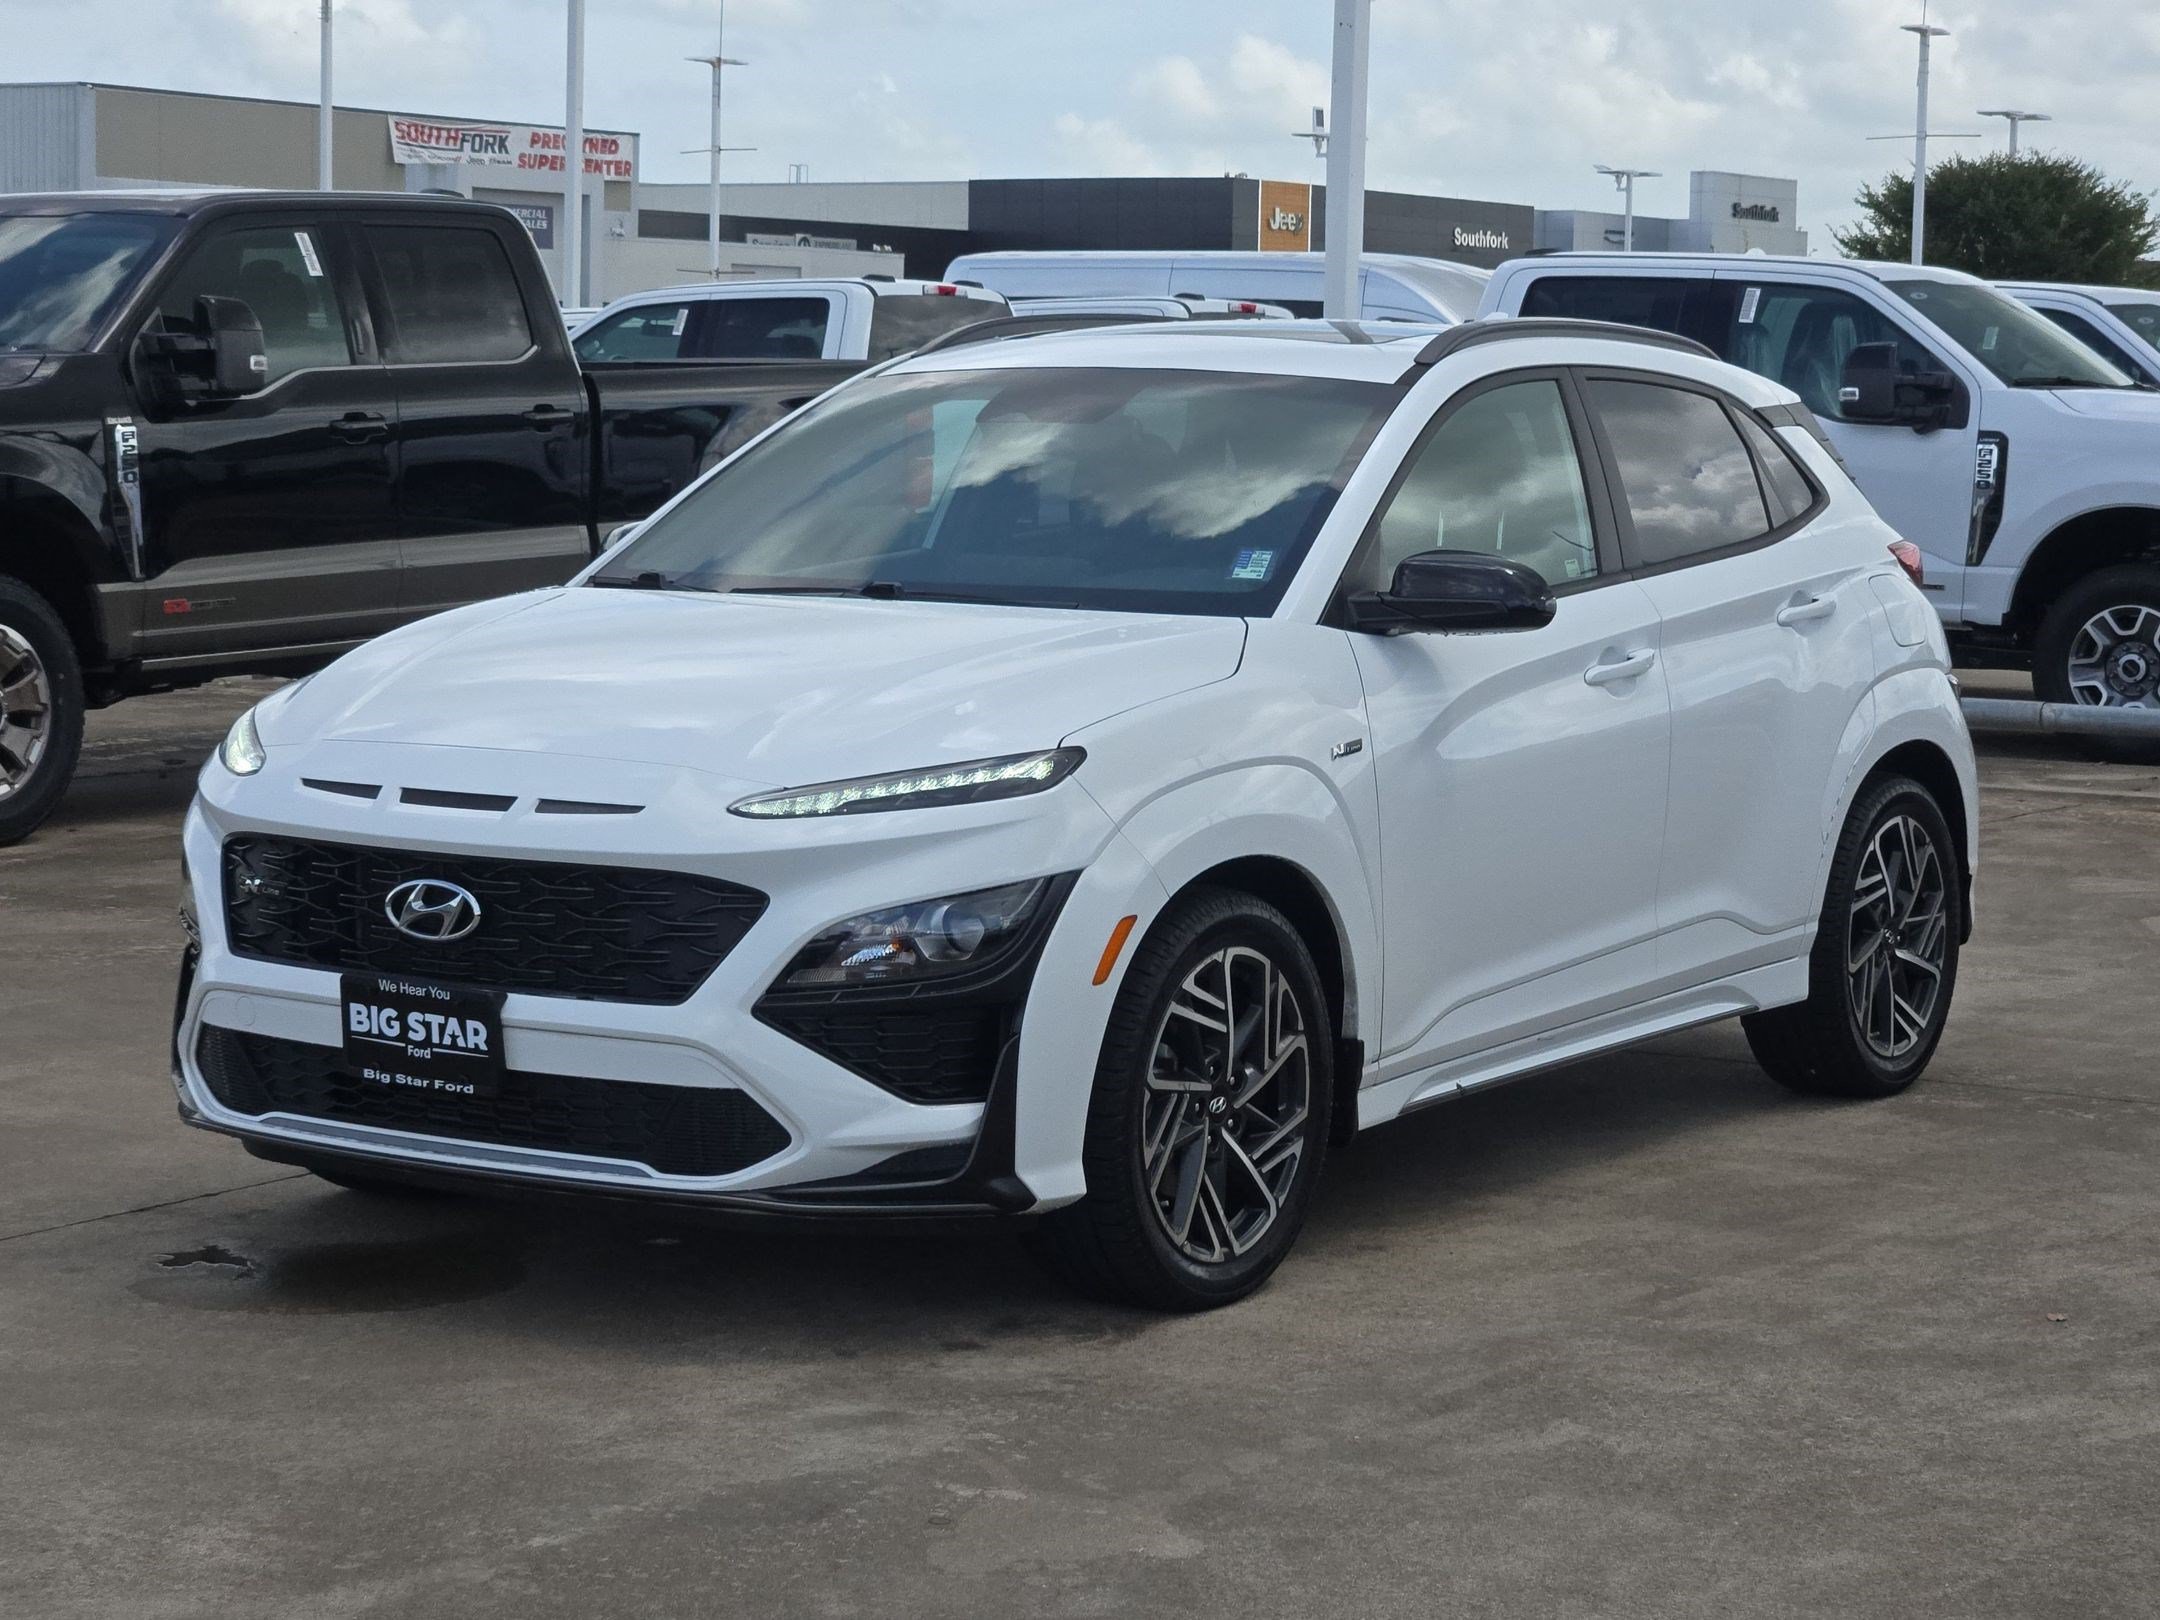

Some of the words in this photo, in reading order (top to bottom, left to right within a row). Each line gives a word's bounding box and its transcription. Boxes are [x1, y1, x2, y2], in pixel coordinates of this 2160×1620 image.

[394, 121, 510, 154] SOUTHFORK
[582, 158, 632, 177] ENTER
[1269, 207, 1303, 235] Jeep
[1454, 227, 1508, 249] Southfork
[1976, 448, 1993, 490] F250
[378, 979, 397, 993] We
[400, 982, 427, 996] Hear
[429, 986, 450, 1000] You
[349, 1002, 400, 1038] BIG
[407, 1011, 488, 1050] STAR
[407, 1045, 431, 1059] Ford
[363, 1068, 391, 1084] Big
[395, 1073, 430, 1088] Star
[434, 1079, 474, 1094] Ford
